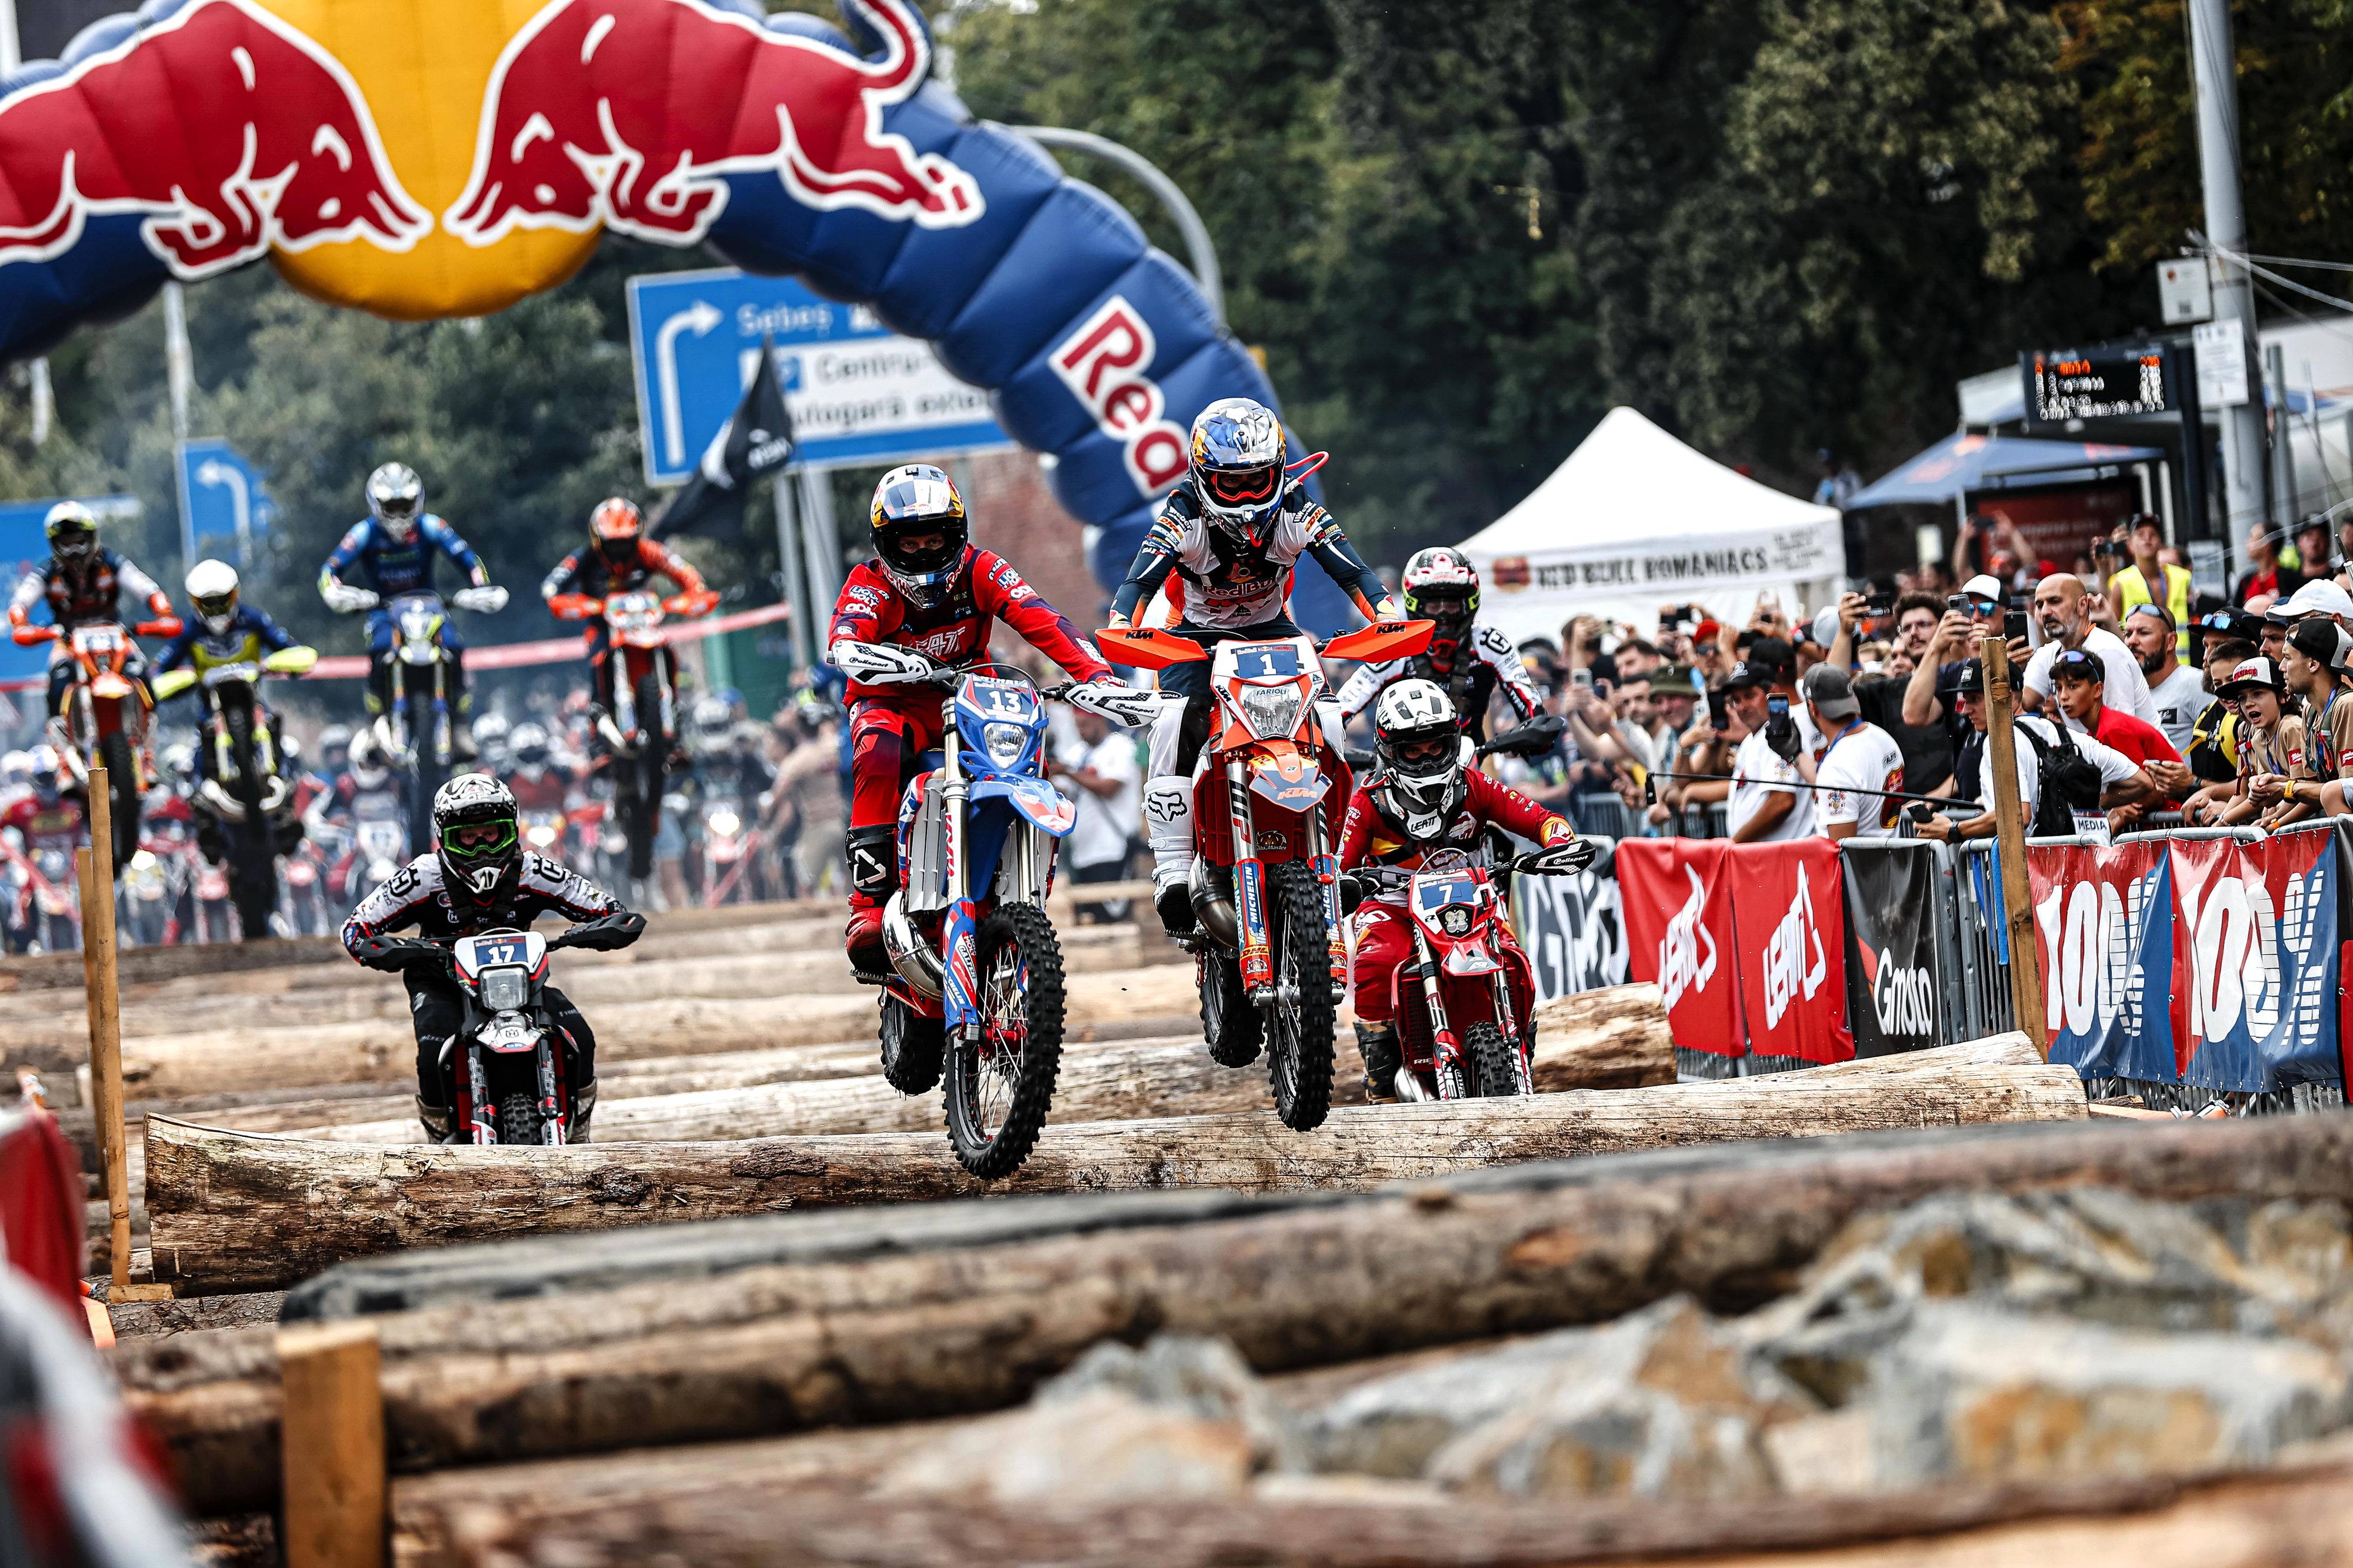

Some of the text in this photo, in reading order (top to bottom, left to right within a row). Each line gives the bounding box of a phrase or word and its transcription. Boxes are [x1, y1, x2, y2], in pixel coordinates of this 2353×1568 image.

[1376, 622, 1405, 634] KTM
[1125, 630, 1154, 639] KTM
[849, 657, 888, 668] Polisport
[1259, 653, 1277, 675] 1
[1215, 685, 1232, 703] KTM
[1256, 688, 1287, 696] FARIOLI
[989, 690, 1021, 713] 13
[1116, 703, 1155, 714] Polisport
[1277, 788, 1318, 800] KTM
[1411, 815, 1438, 832] LEATT
[2078, 819, 2107, 830] MEDIA
[1554, 855, 1588, 865] Polisport
[1244, 866, 1258, 923] MICHELIN
[1439, 885, 1453, 904] 7
[488, 945, 515, 964] 17
[1242, 946, 1268, 956] DHL
